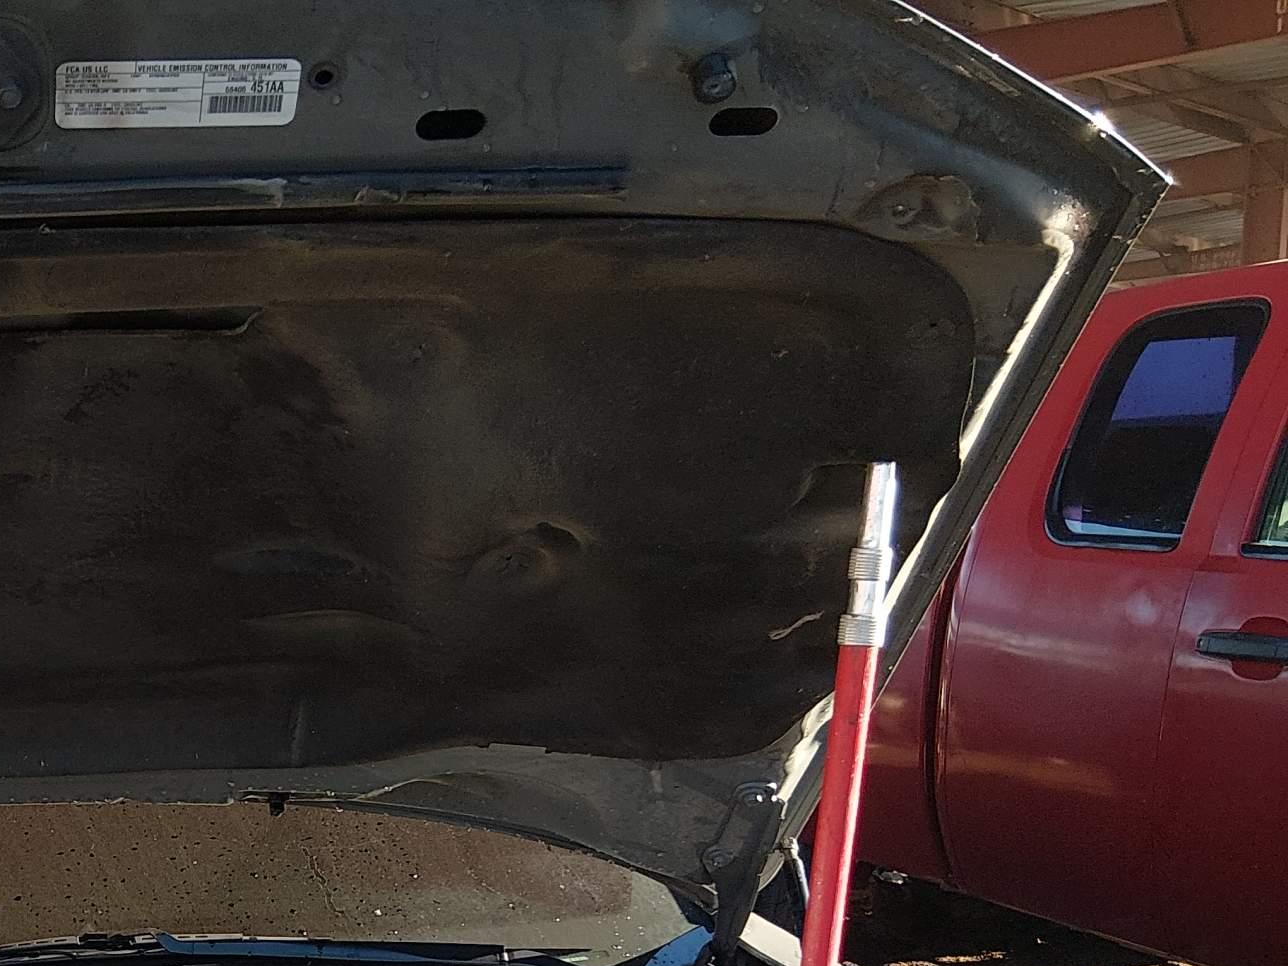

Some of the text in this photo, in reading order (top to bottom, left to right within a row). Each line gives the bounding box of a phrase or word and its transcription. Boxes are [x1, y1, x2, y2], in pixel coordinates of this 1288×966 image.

[65, 65, 109, 73] FCA US LLC
[137, 63, 288, 73] VEHICLE EMISSION CONTROL INFORMATION
[250, 80, 285, 93] 451AA
